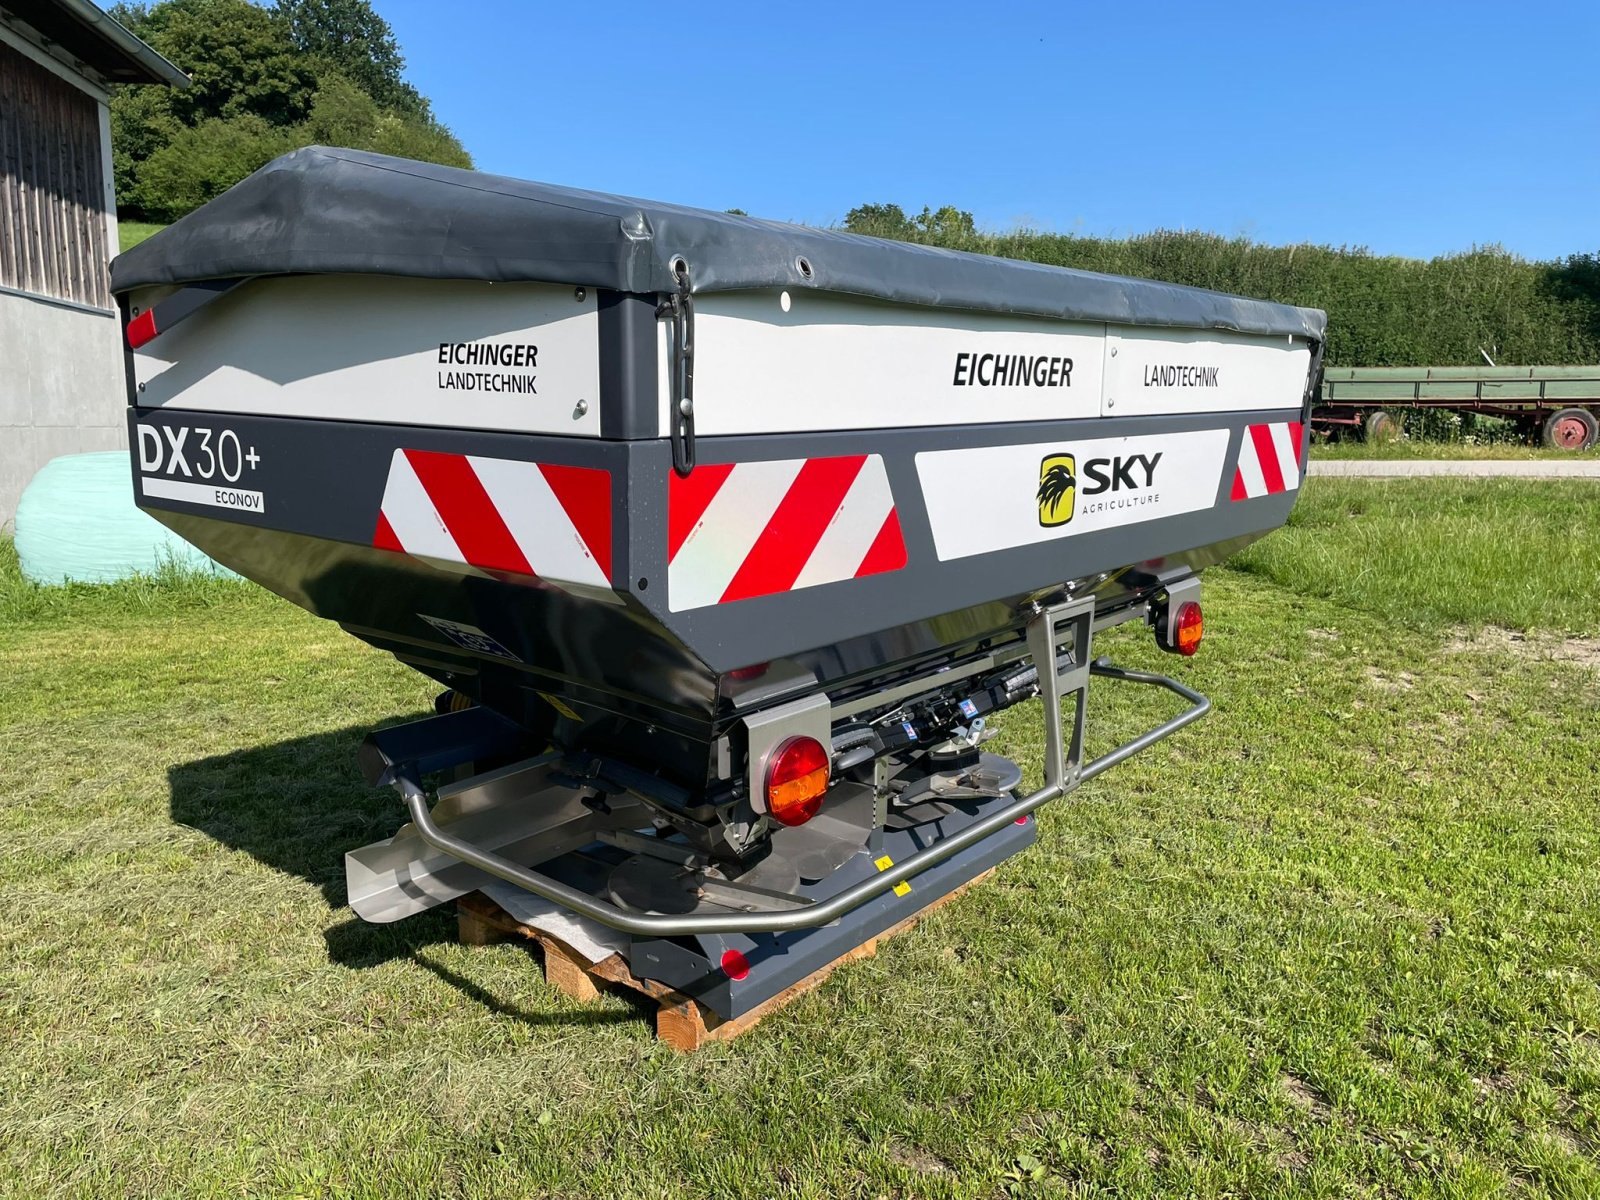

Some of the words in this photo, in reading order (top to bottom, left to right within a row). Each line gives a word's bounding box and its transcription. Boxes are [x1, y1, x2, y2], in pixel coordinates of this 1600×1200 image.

[438, 343, 538, 367] EICHINGER
[953, 353, 1074, 387] EICHINGER
[1144, 364, 1219, 387] LANDTECHNIK
[438, 371, 538, 394] LANDTECHNIK
[136, 423, 261, 482] DX30+
[1082, 452, 1163, 495] SKY
[215, 490, 260, 508] ECONOV
[1082, 493, 1160, 515] AGRICULTURE
